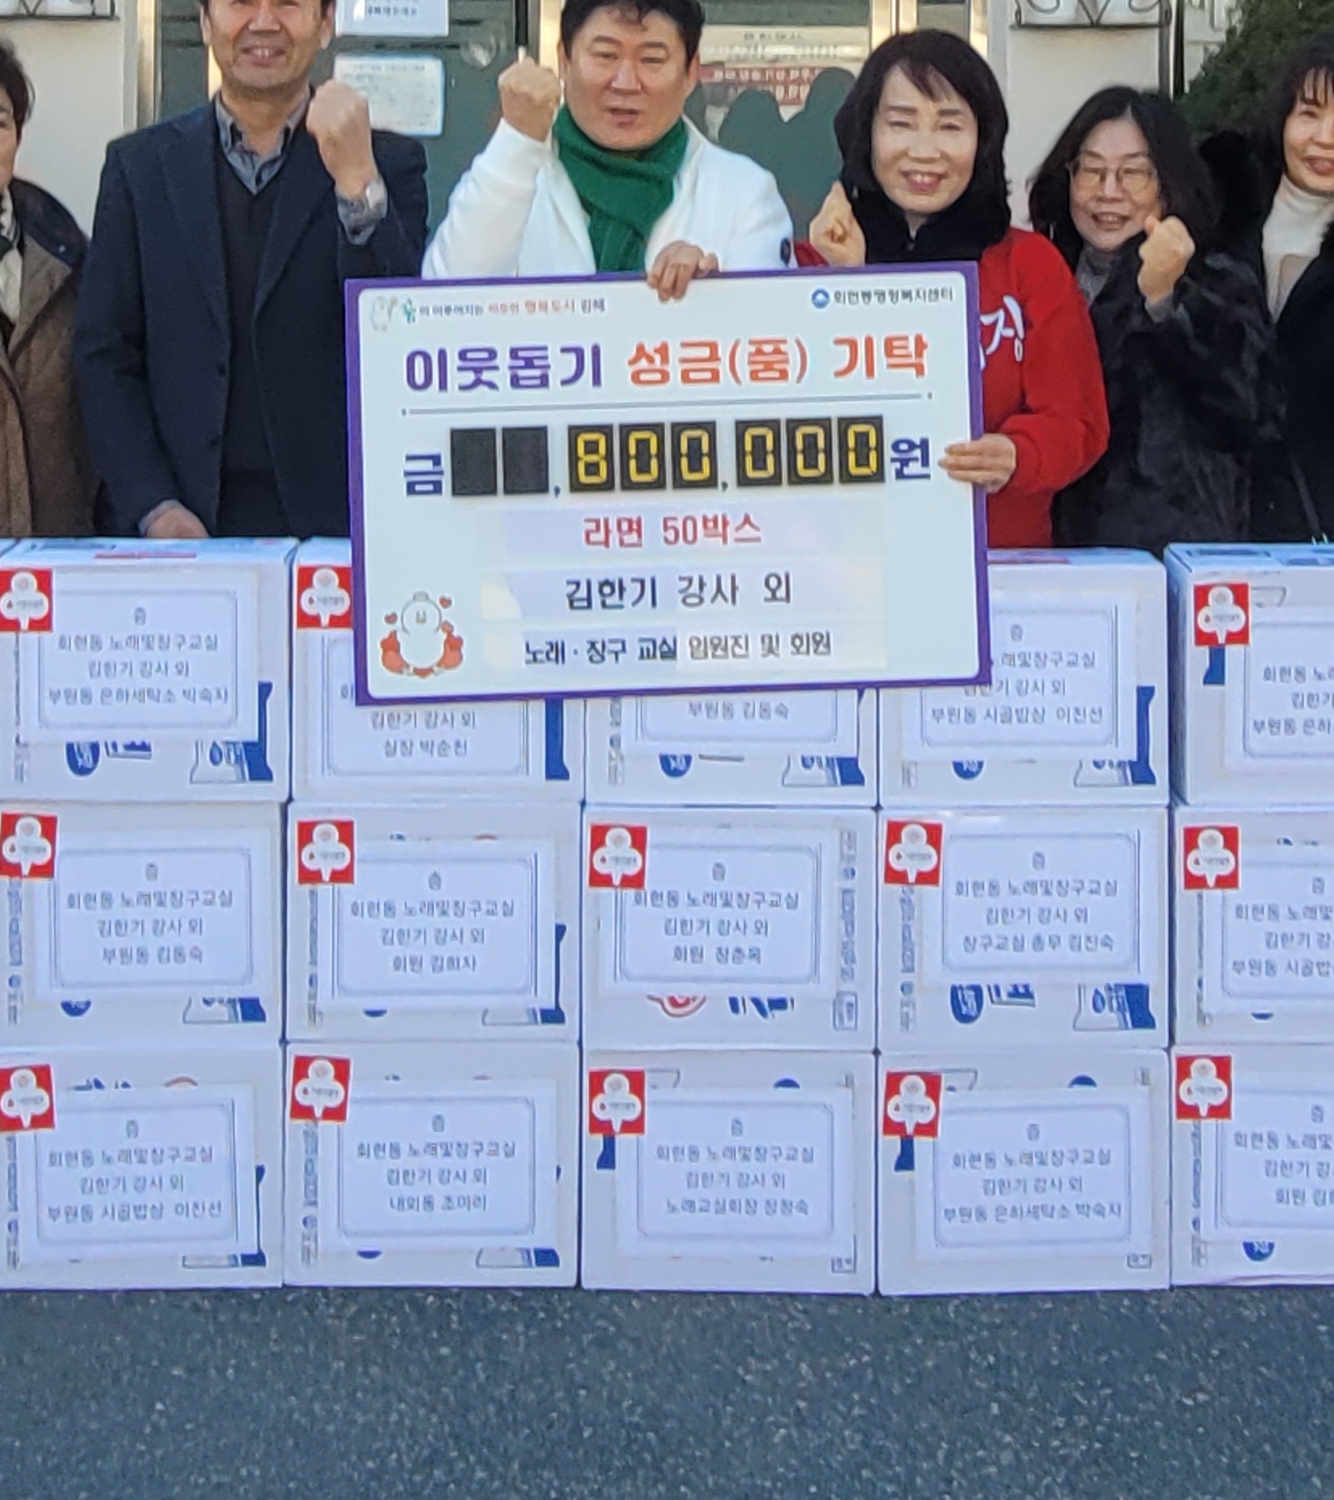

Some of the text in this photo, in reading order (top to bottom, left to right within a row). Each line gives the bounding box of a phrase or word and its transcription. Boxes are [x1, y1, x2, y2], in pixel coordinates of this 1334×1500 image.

[405, 332, 929, 393] 이웃돕기 성금(품) 기탁
[403, 454, 445, 497] 금
[890, 437, 932, 481] 원
[583, 513, 763, 549] 라면 50박스
[565, 571, 793, 611] 김한기 강사 외
[637, 635, 679, 663] 교실
[688, 632, 750, 660] 임원진
[761, 632, 780, 658] 및
[790, 631, 832, 657] 회원
[996, 650, 1096, 670] 래및장구교실
[1263, 666, 1306, 684] 회현동
[1012, 678, 1065, 698] 강사 외
[1292, 692, 1334, 709] 김한기
[371, 711, 475, 730] 김한기 강사 외
[67, 891, 114, 911] 회현동
[634, 888, 679, 908] 회현동
[351, 900, 396, 919] 회현동
[1235, 904, 1279, 922] 회현동
[98, 918, 203, 938] 김한기 강사 외
[381, 927, 484, 946] 김한기 강사 외
[664, 917, 768, 937] 김한기 강사 외
[1265, 931, 1310, 949] 김한기
[1234, 1131, 1279, 1150] 회현동
[357, 1142, 401, 1160] 회현동
[657, 1145, 700, 1163] 회현동
[387, 1167, 487, 1186] 김한기 강사 외
[1265, 1159, 1310, 1178] 김한기
[686, 1172, 785, 1189] 김한기 강사 외
